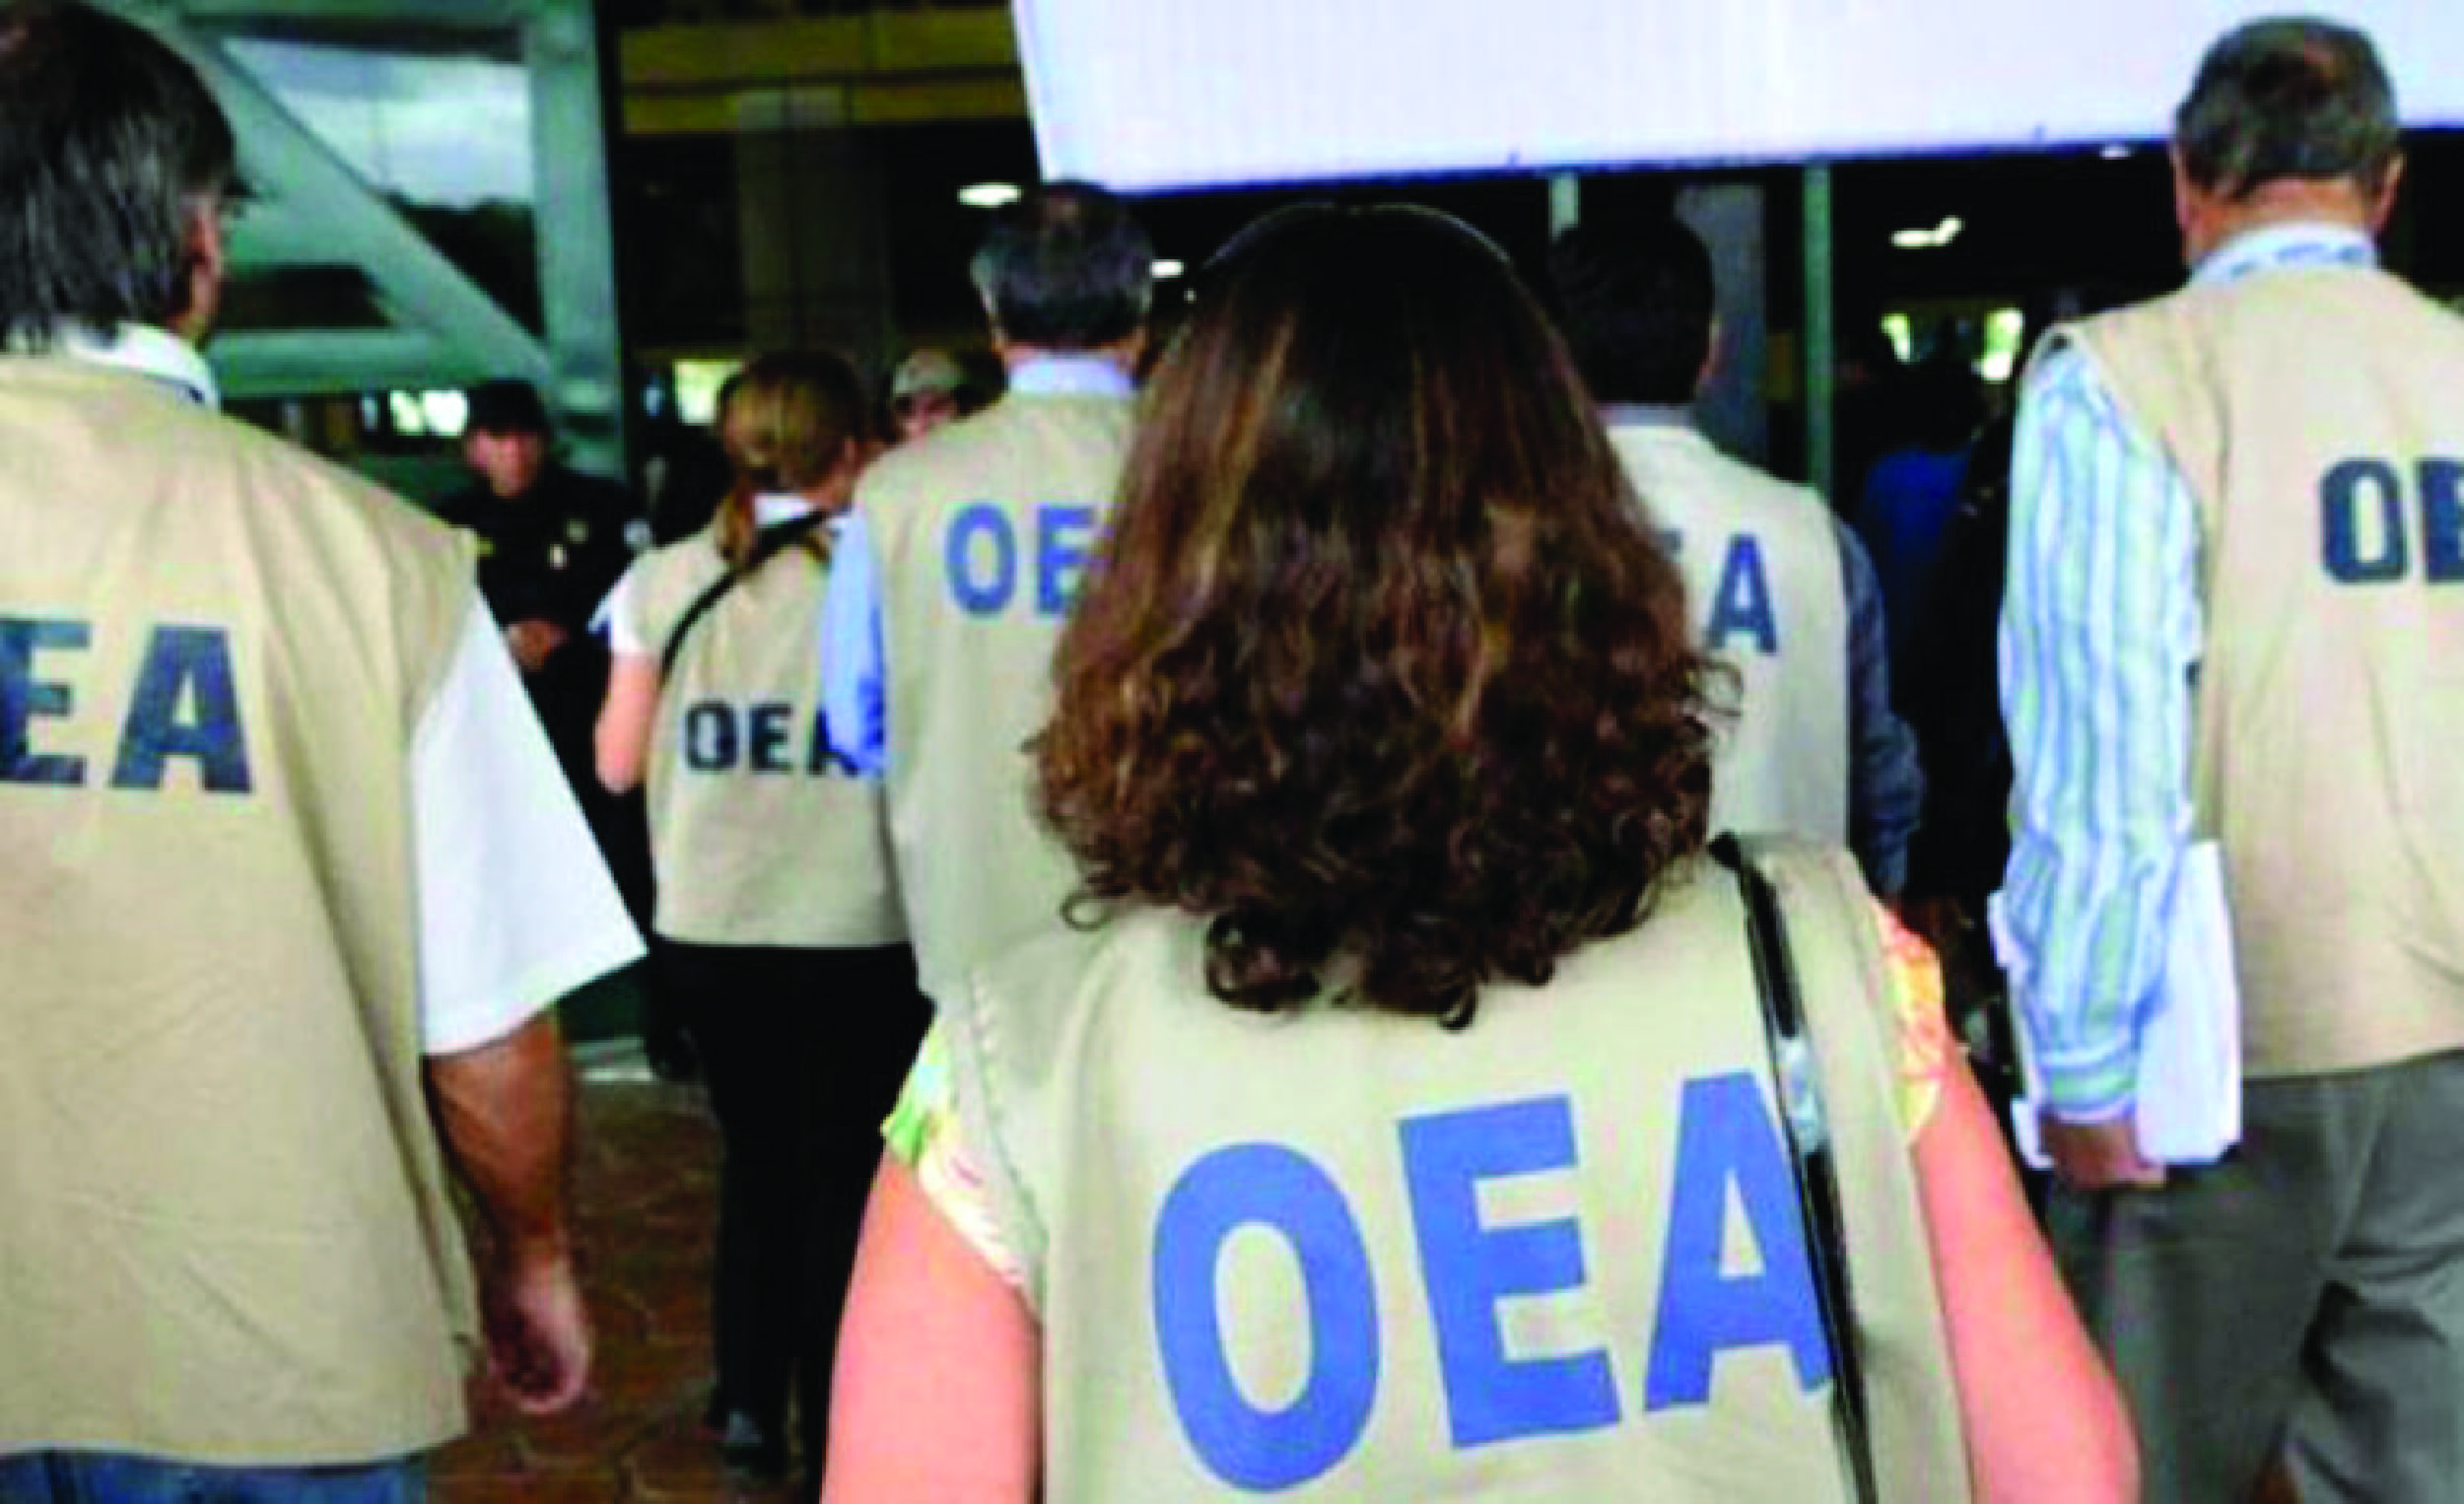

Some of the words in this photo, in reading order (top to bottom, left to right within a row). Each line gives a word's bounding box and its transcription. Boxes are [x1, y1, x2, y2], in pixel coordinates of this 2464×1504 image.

[1652, 528, 1778, 655] A
[685, 700, 861, 777] OEA
[1152, 1070, 1831, 1493] OEA
